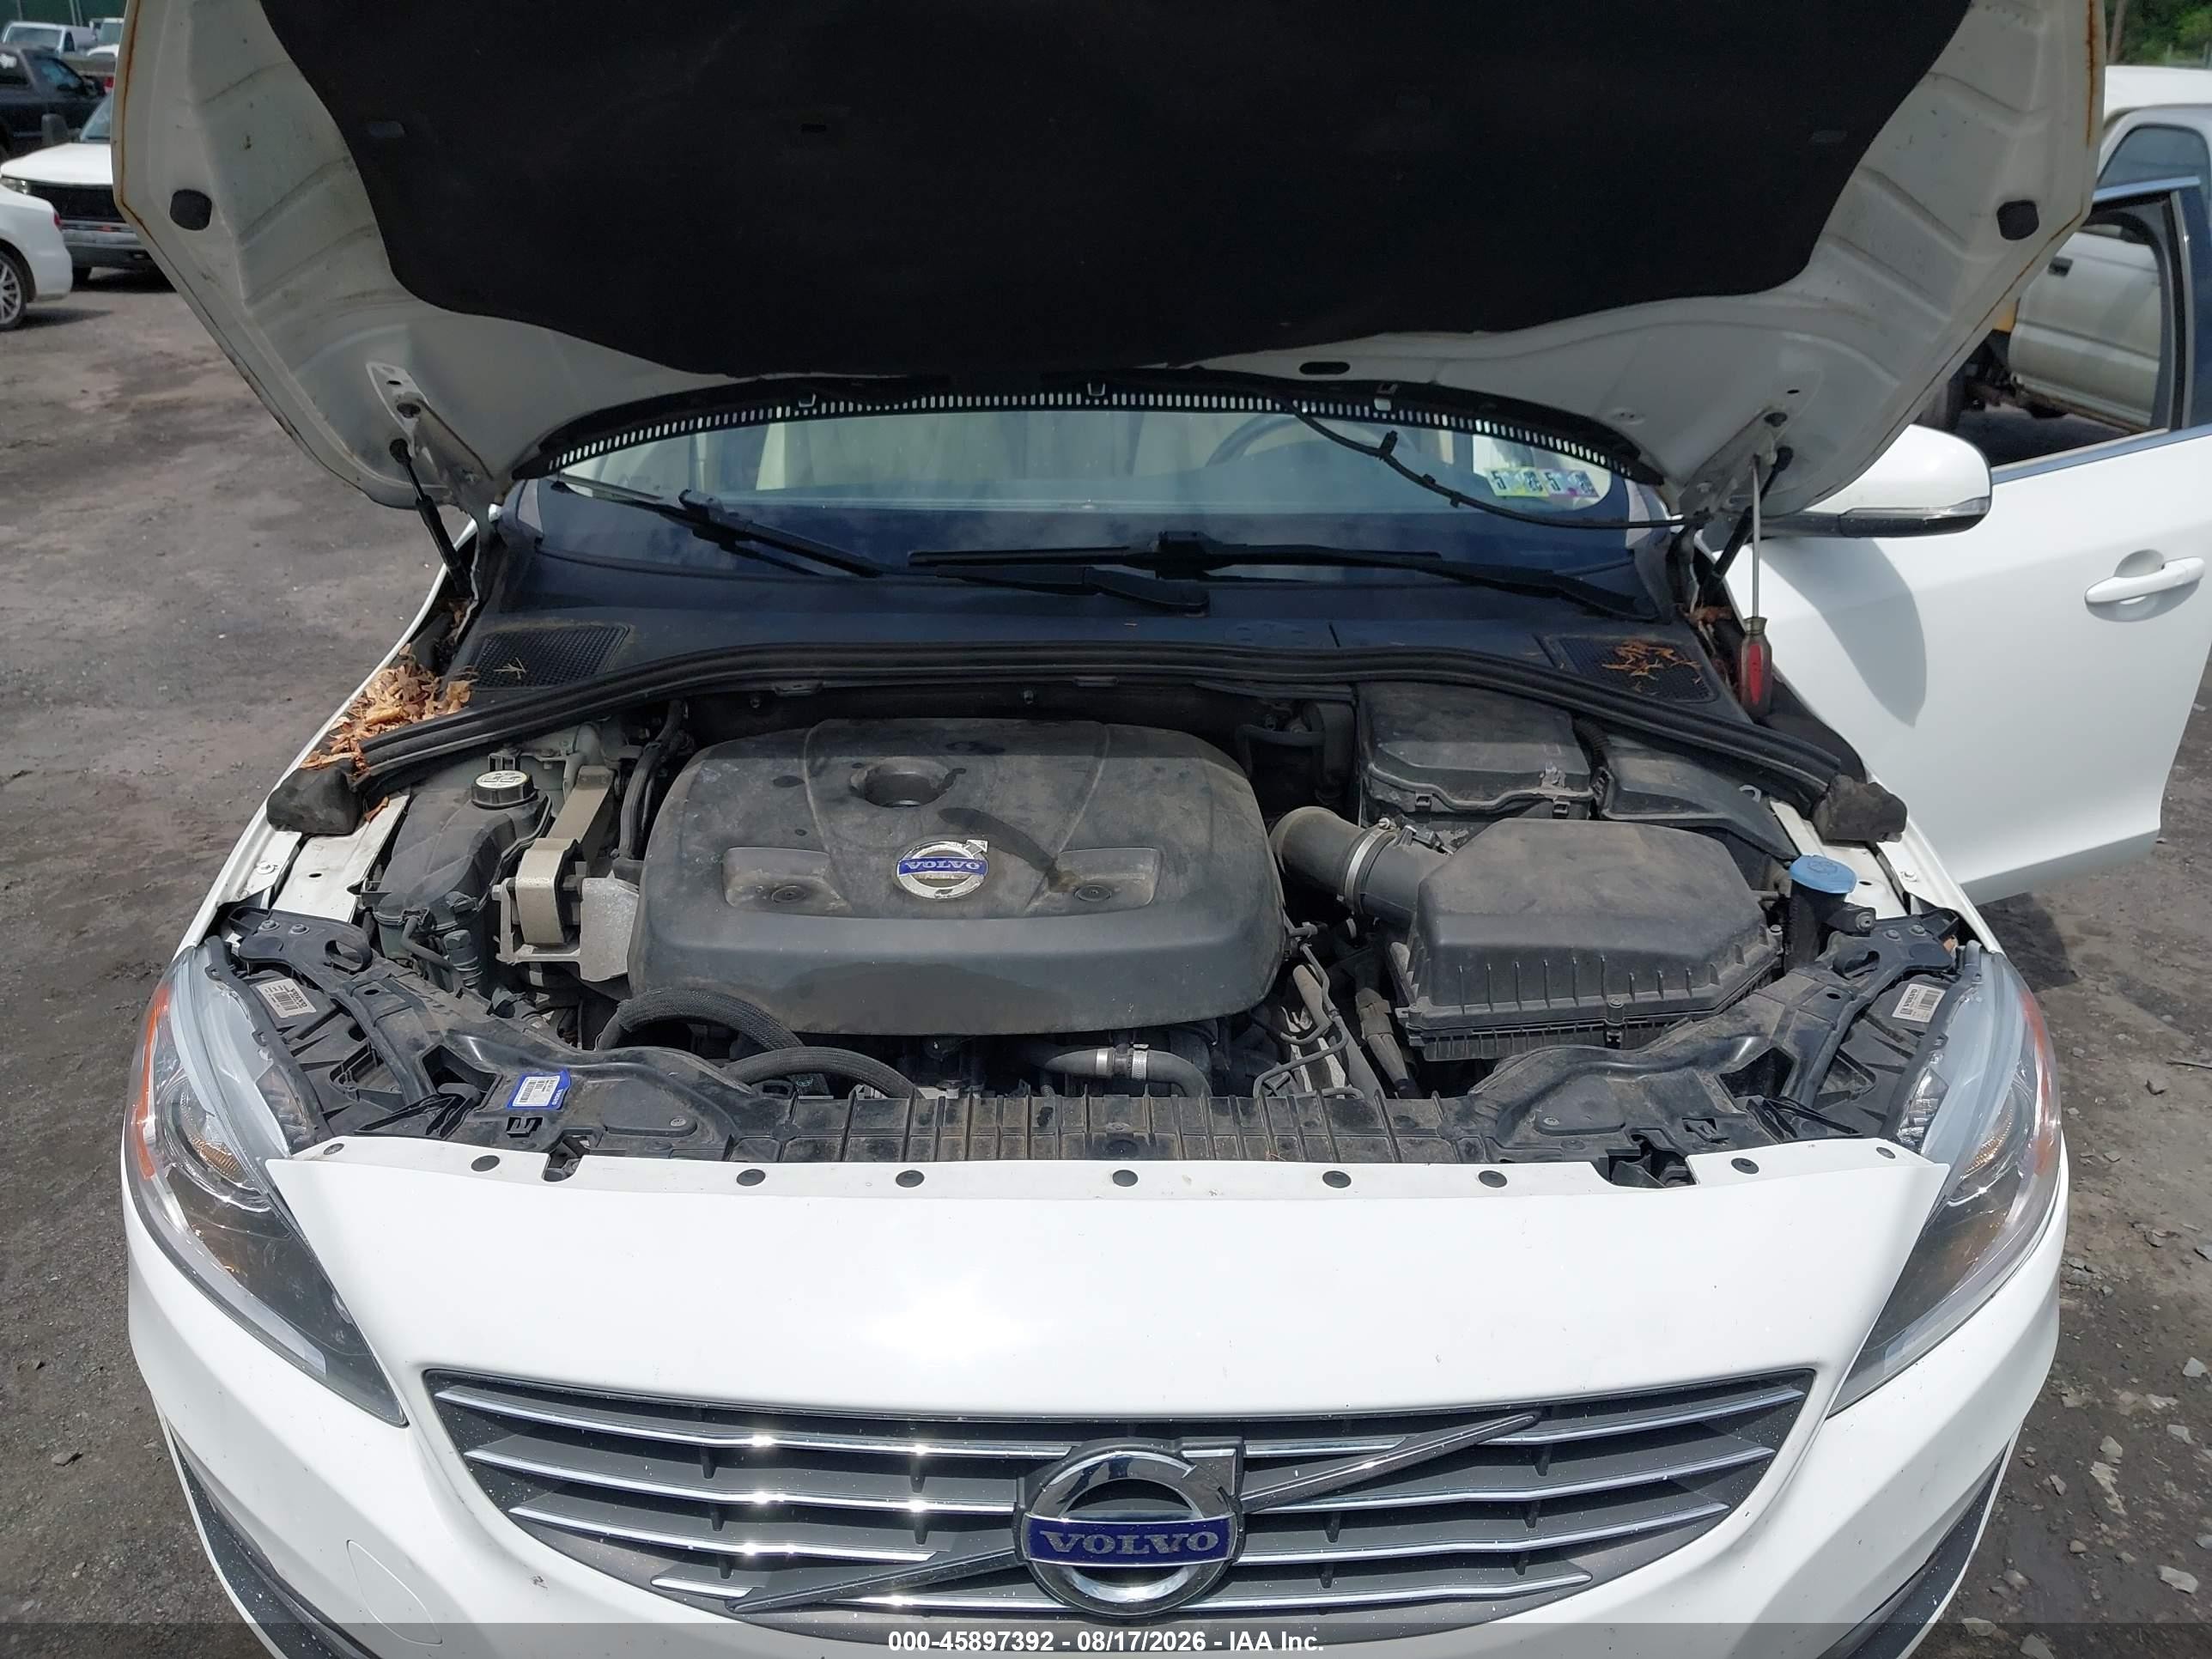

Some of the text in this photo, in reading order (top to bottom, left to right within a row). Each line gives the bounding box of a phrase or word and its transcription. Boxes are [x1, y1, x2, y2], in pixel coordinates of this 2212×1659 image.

[1491, 471, 1506, 490] 5
[1545, 469, 1561, 491] 5
[905, 861, 980, 870] VOLVO
[1040, 1530, 1219, 1555] VOLVO
